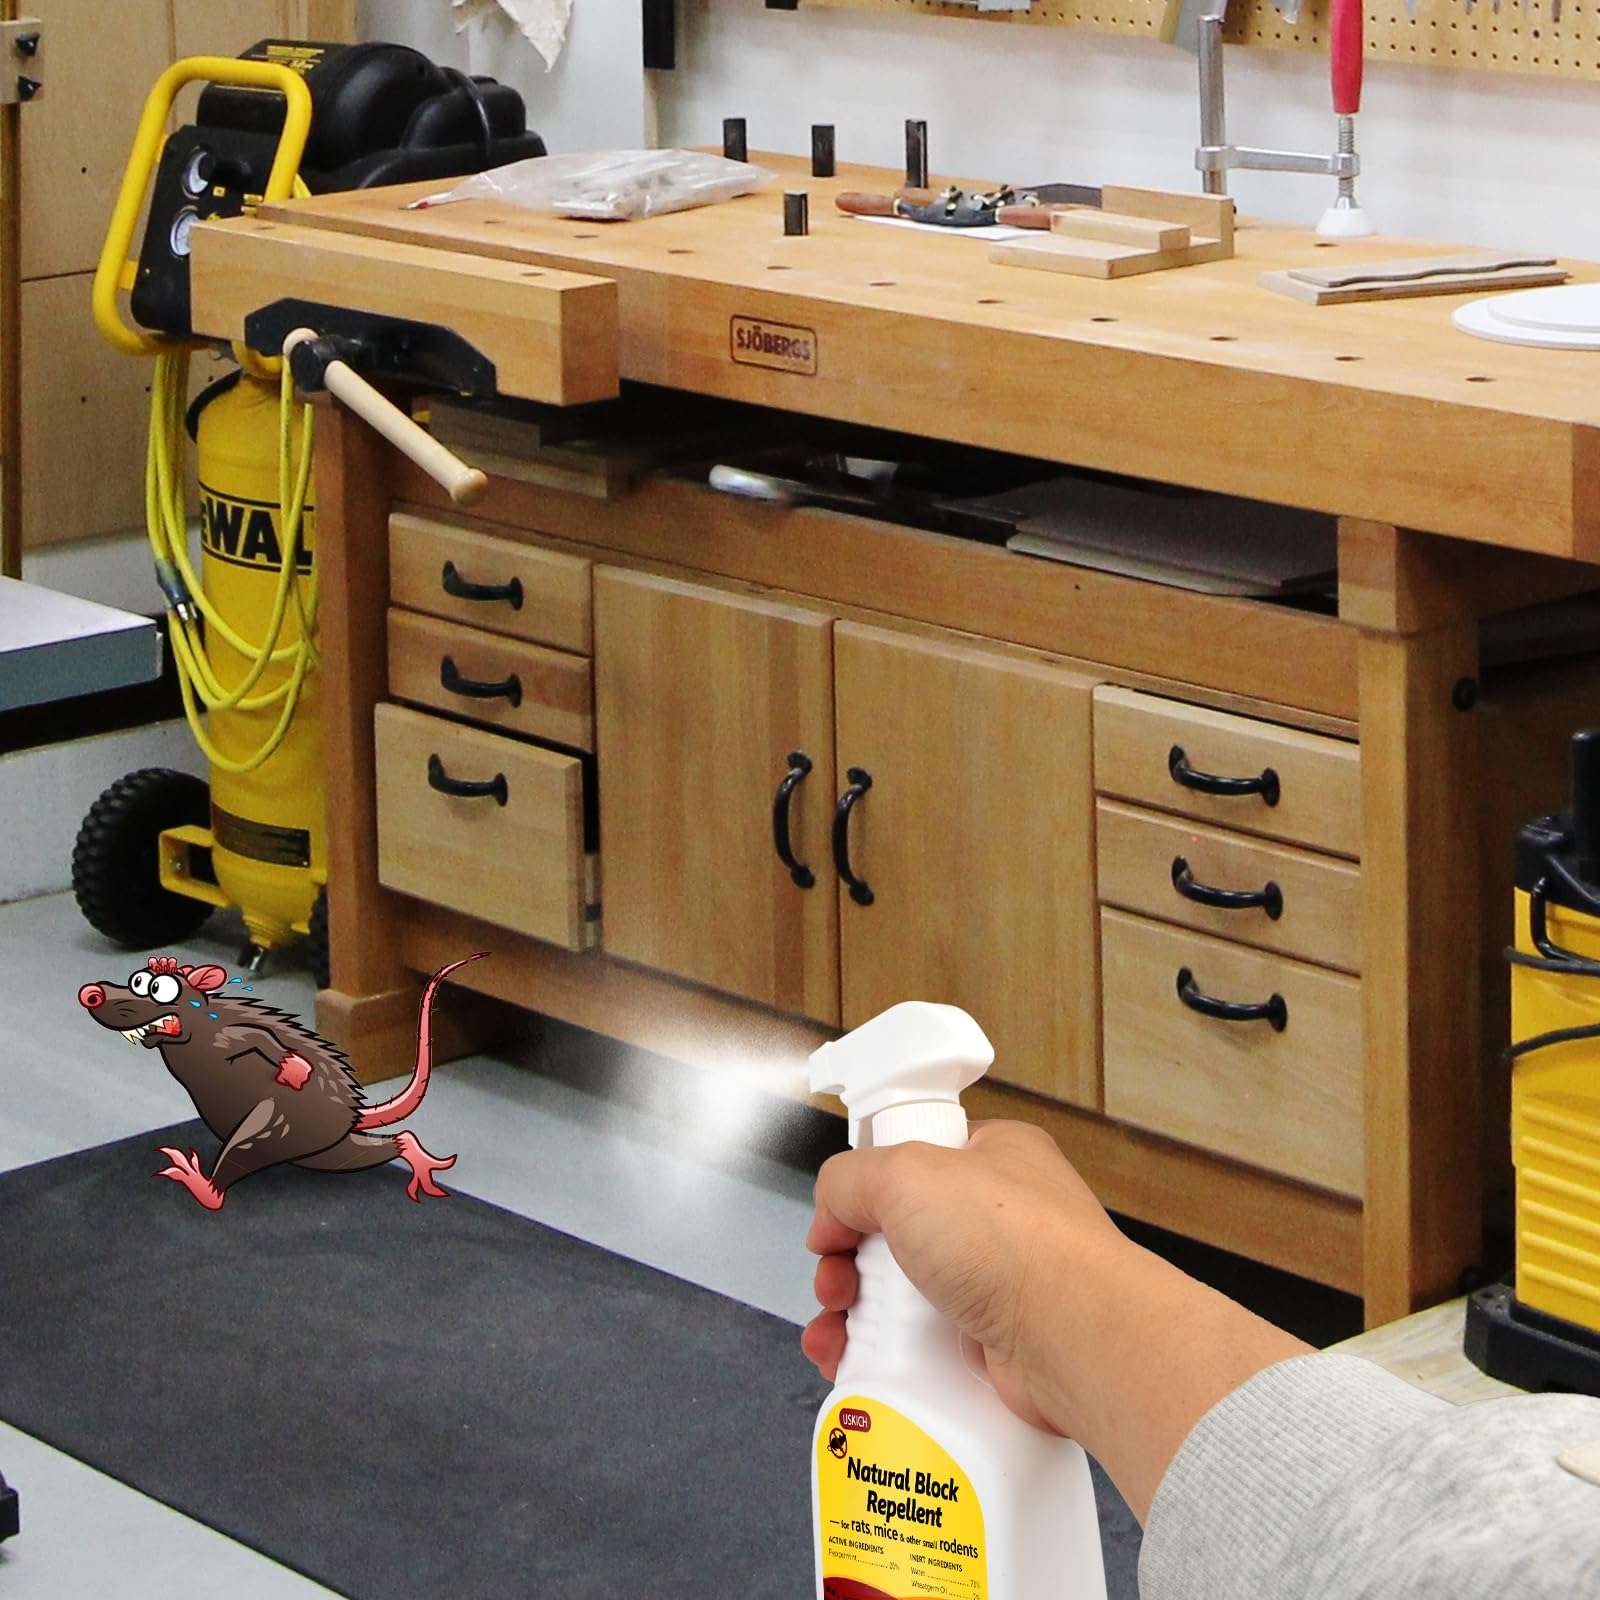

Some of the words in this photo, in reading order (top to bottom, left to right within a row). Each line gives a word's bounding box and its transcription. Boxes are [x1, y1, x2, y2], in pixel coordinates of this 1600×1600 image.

[847, 1456, 911, 1492] Natural
[914, 1471, 960, 1503] Block
[866, 1489, 943, 1528] Repellent
[848, 1539, 884, 1555] INGREDIENTS
[874, 1523, 899, 1541] mice
[906, 1535, 921, 1546] other
[939, 1537, 979, 1559] rodents
[927, 1557, 963, 1573] INGREDIENTS
